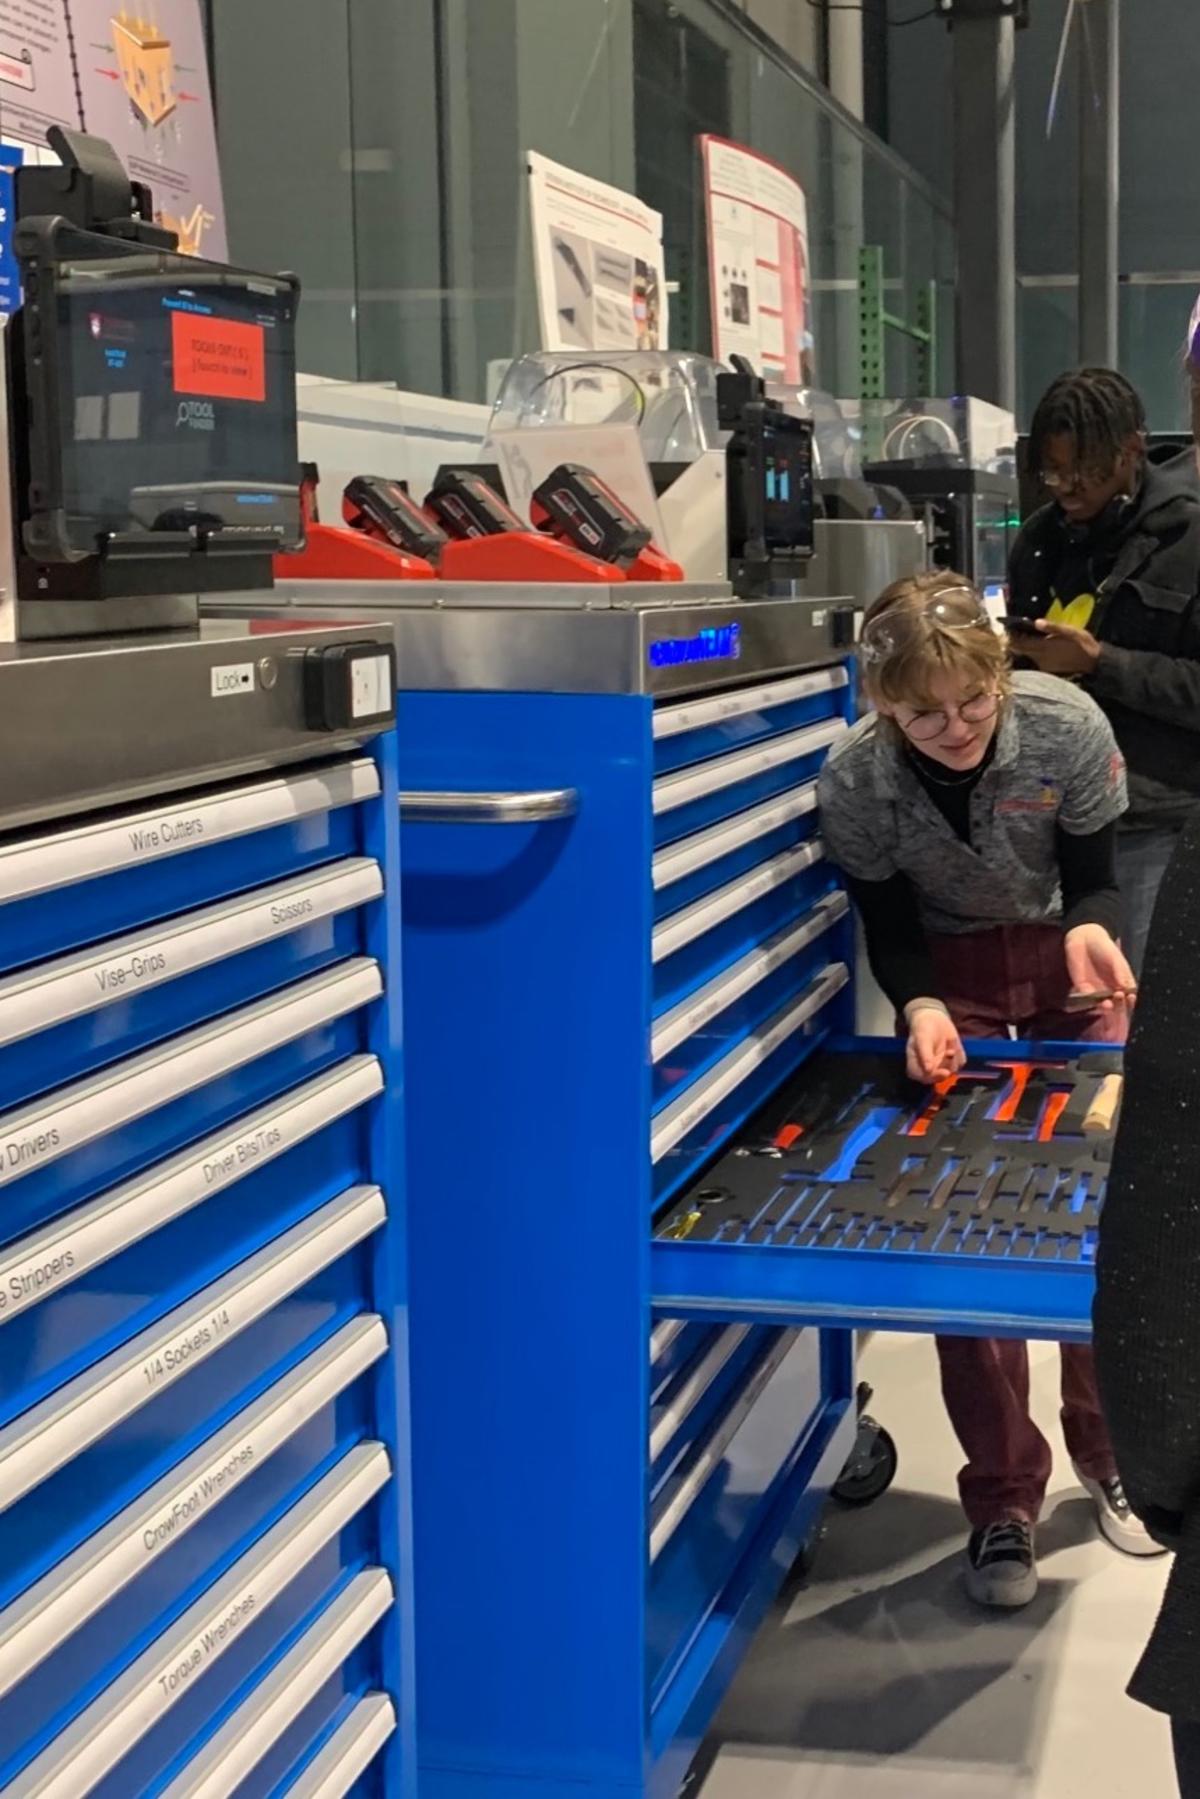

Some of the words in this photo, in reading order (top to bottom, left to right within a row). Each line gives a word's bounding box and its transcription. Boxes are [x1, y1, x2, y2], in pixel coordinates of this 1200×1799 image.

[188, 401, 215, 418] TOOL
[216, 671, 241, 691] Lock
[128, 828, 159, 852] Wire
[161, 816, 204, 845] Cutters
[271, 897, 313, 925] Scissors
[95, 953, 166, 991] Vise-Grips
[6, 1128, 60, 1166] Drivers
[202, 1153, 235, 1184] Driver
[235, 1128, 281, 1163] Bits/Tips
[9, 1250, 75, 1301] Strippers
[143, 1358, 164, 1385] 1/4
[164, 1328, 212, 1371] Sockets
[211, 1310, 230, 1333] 1/4
[143, 1491, 201, 1551] CrowFoot
[199, 1445, 254, 1498] Wrenches
[158, 1649, 202, 1697] Torque
[201, 1594, 256, 1653] Wrenches
